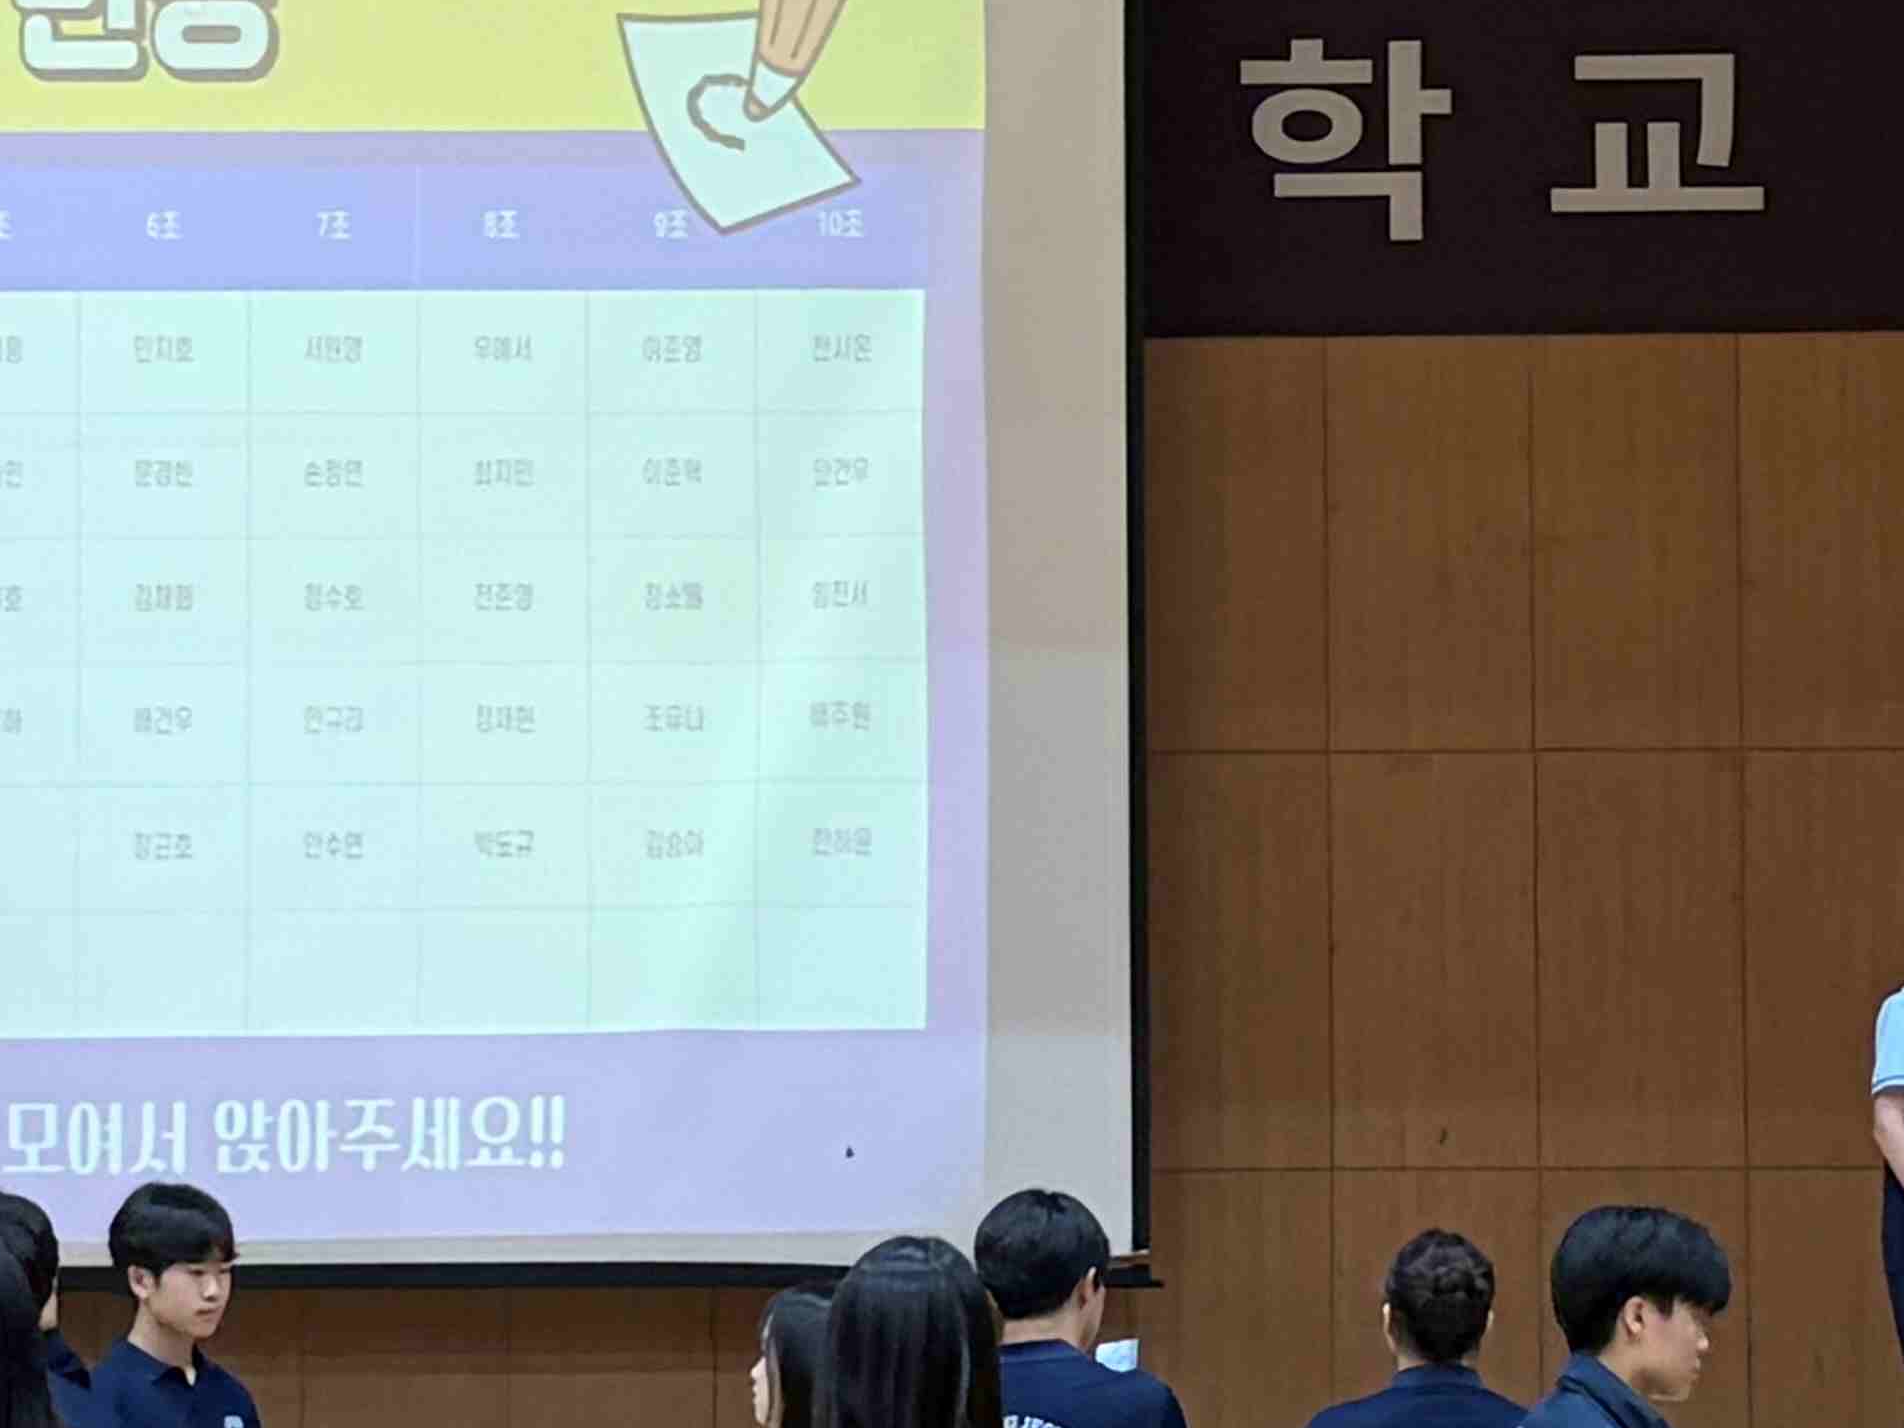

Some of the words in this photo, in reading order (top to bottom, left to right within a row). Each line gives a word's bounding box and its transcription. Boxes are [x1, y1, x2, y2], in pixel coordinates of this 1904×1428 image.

[1240, 39, 1452, 241] 학
[1551, 54, 1764, 212] 교
[147, 211, 180, 239] 6조
[317, 211, 350, 239] 7조
[653, 210, 688, 239] 9조
[818, 210, 863, 238] 10조
[2, 1101, 187, 1176] 모여서
[214, 1094, 564, 1173] 앉아주세요!!
